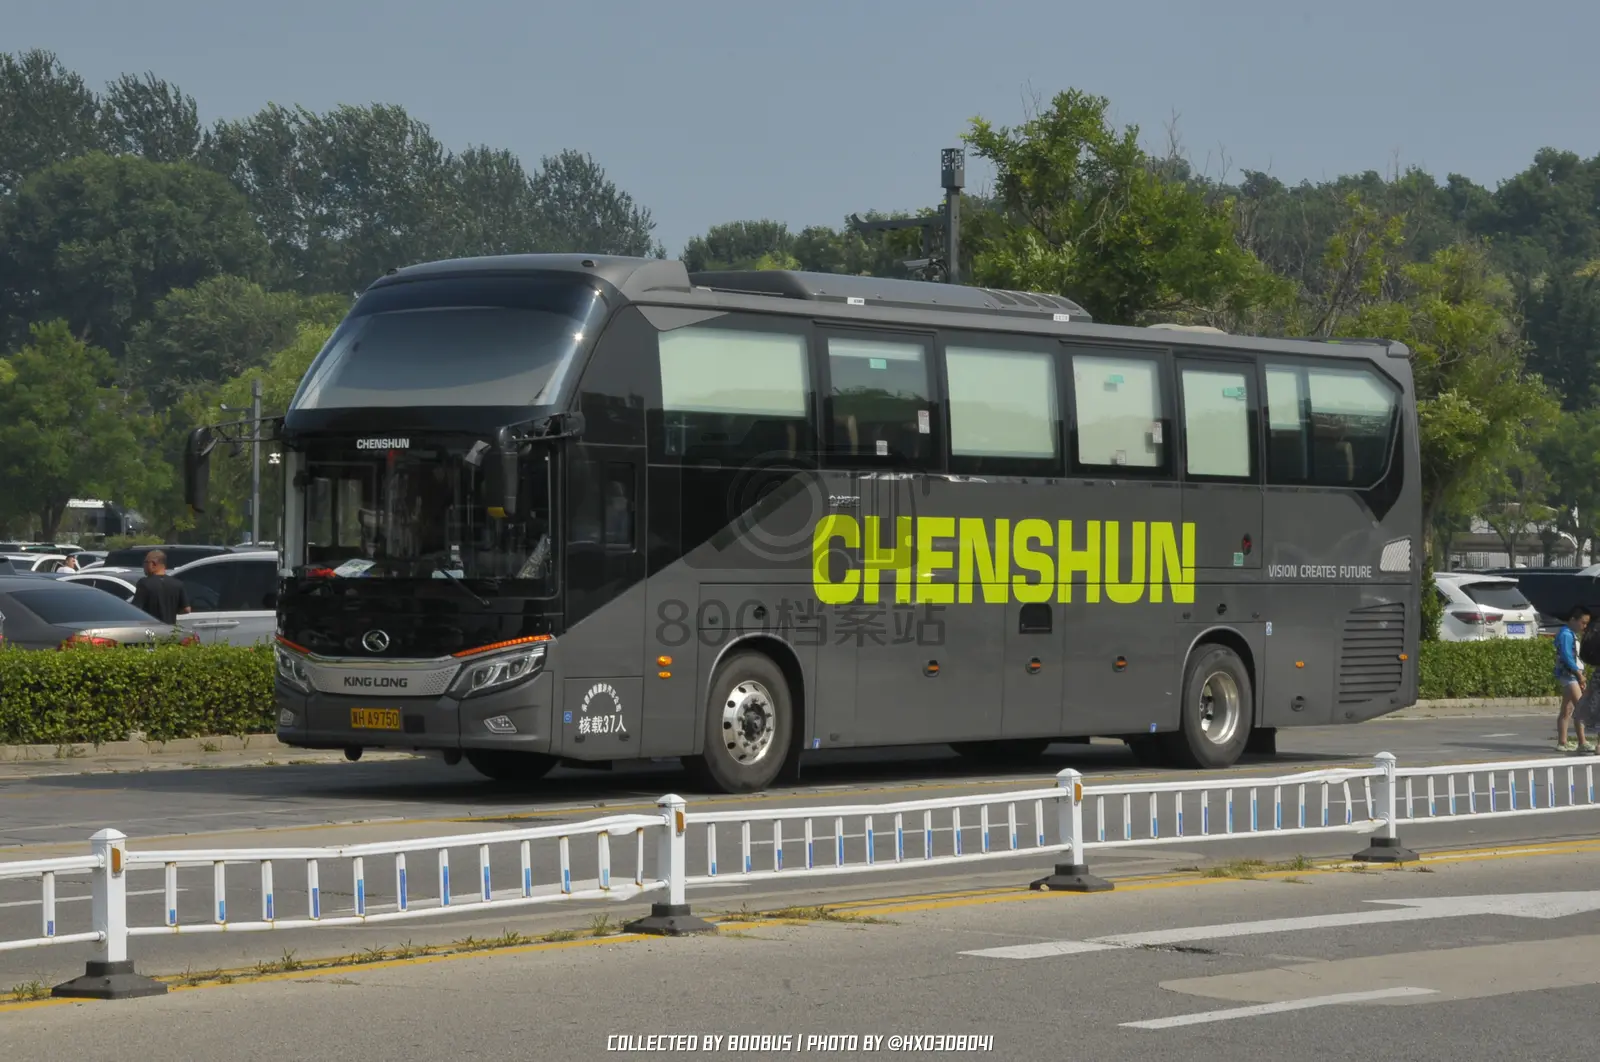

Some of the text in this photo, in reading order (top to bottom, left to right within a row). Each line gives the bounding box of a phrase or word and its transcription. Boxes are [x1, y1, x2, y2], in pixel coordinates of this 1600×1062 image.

[356, 438, 410, 449] CHENSHUN
[812, 514, 1196, 605] CHENSHUN
[1268, 565, 1372, 578] VISION CREATES FUTURE
[344, 676, 408, 688] KING LONG
[578, 714, 627, 735] 核载37人
